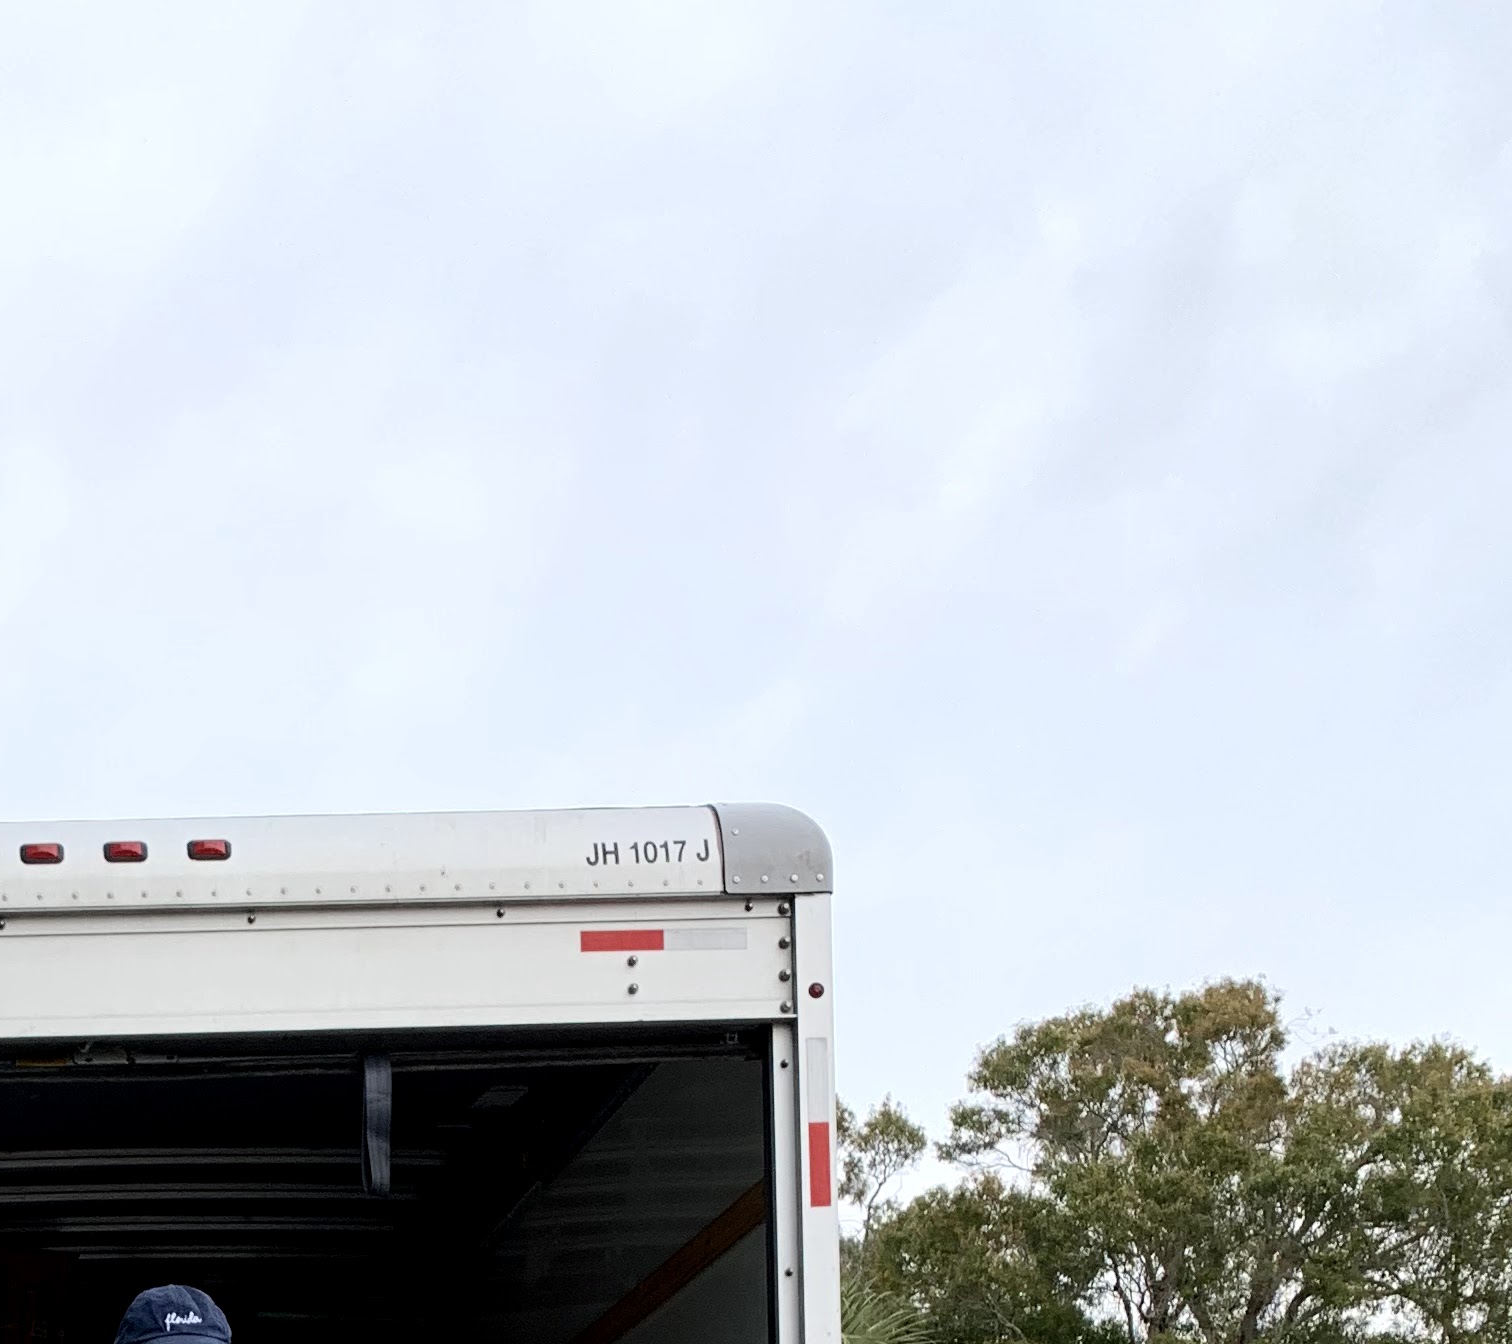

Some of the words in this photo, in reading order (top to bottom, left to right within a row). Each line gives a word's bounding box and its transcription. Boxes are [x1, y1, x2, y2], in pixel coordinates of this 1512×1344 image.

[586, 842, 619, 866] JH
[629, 840, 686, 864] 1017
[696, 838, 710, 862] J
[164, 1311, 202, 1331] florida
